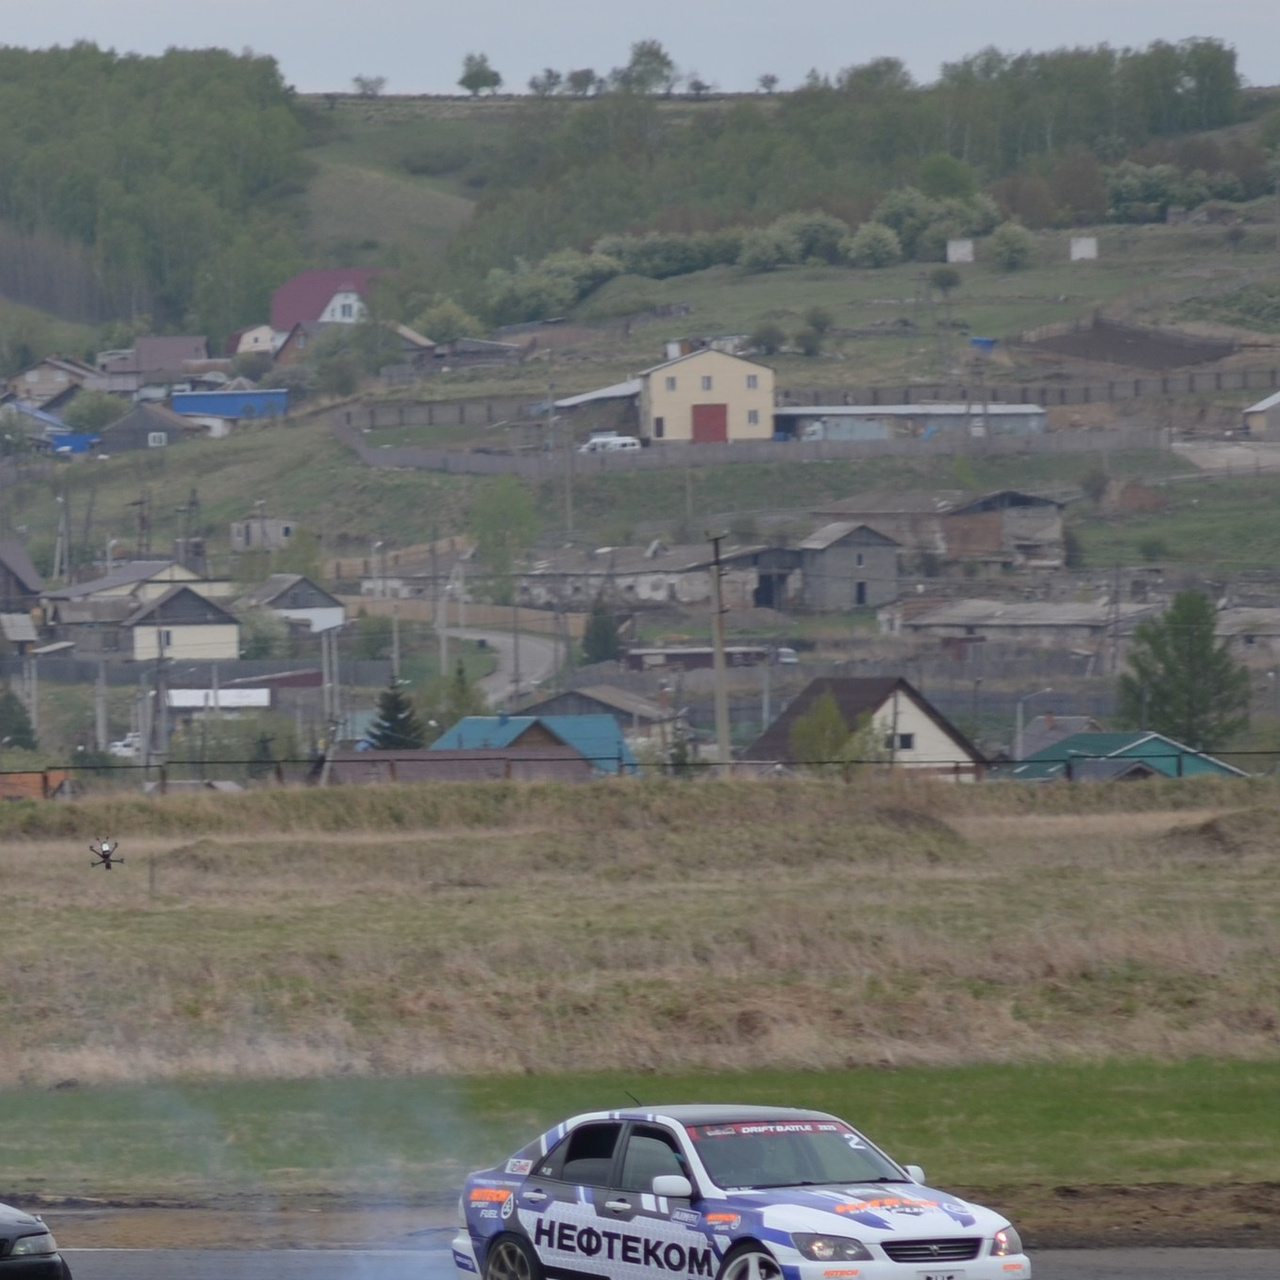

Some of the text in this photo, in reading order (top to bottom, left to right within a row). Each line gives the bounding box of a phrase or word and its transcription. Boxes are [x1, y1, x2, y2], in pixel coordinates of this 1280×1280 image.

[742, 1126, 775, 1134] DRIFT
[844, 1133, 866, 1150] 2
[534, 1218, 714, 1278] НЕФТЕКОМ
